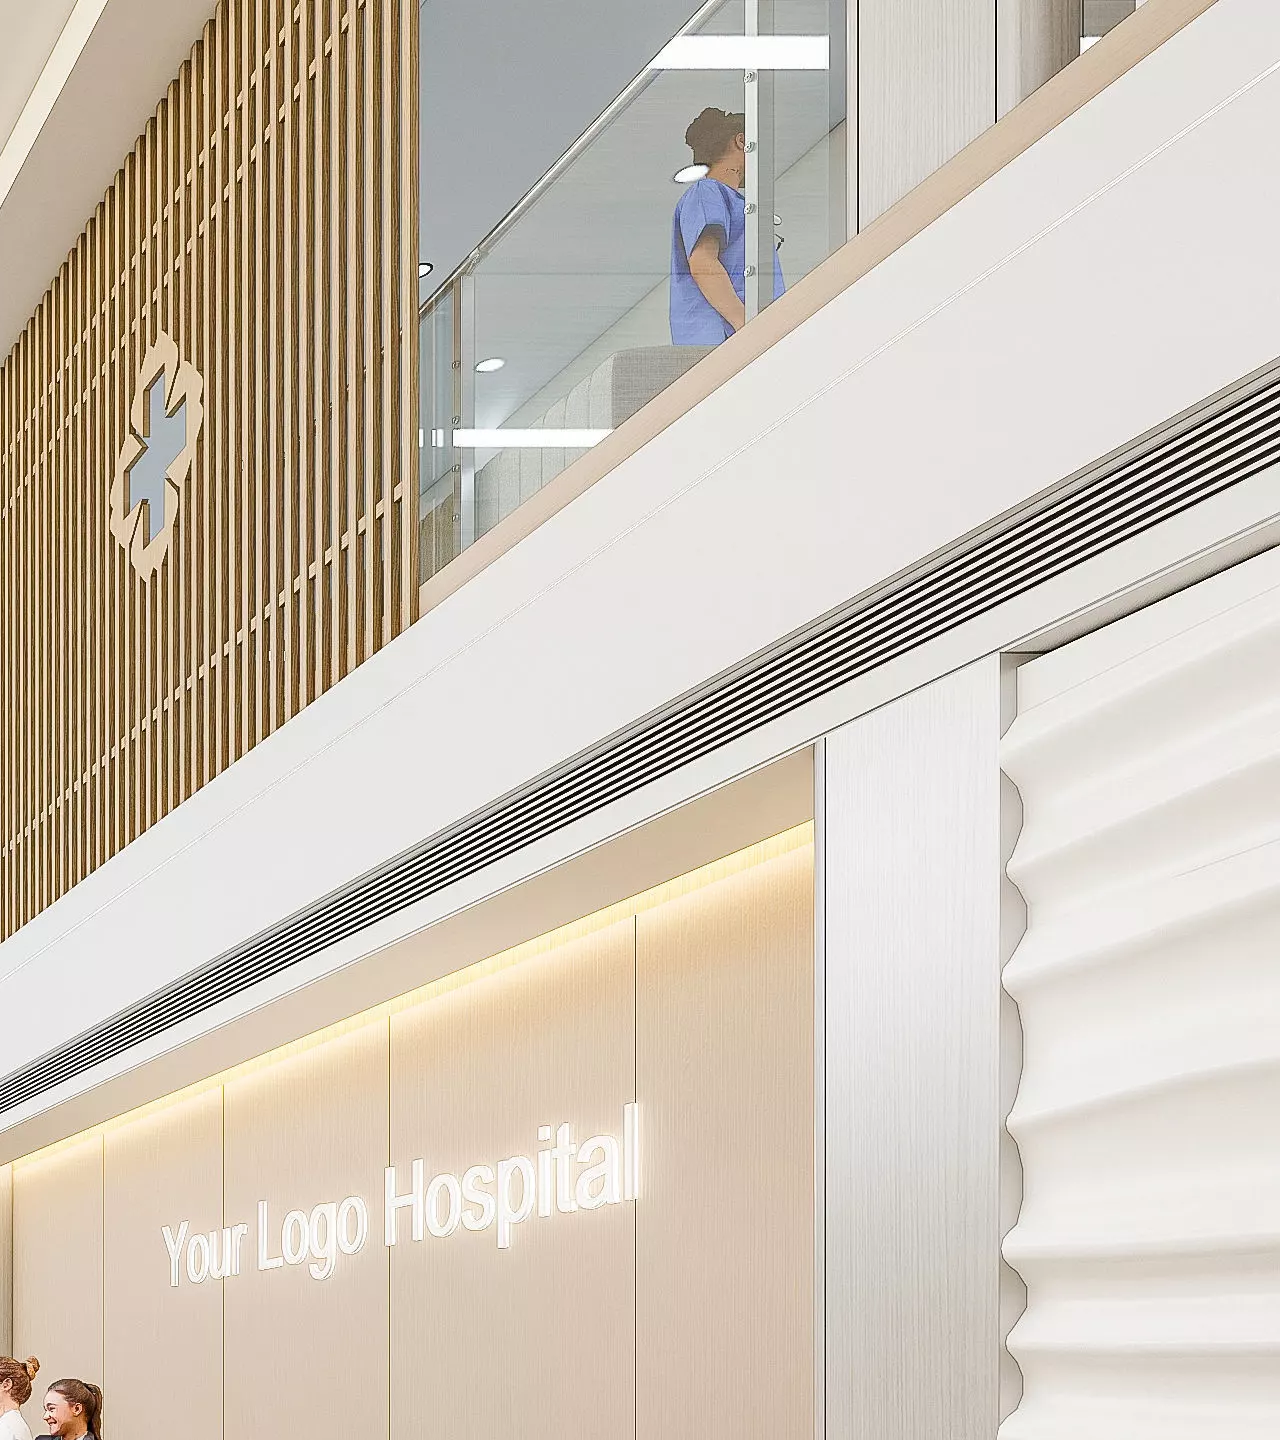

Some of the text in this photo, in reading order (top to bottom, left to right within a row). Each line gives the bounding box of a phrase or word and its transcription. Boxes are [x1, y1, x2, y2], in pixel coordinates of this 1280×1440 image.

[161, 1102, 640, 1288] Your Logo Hospital
